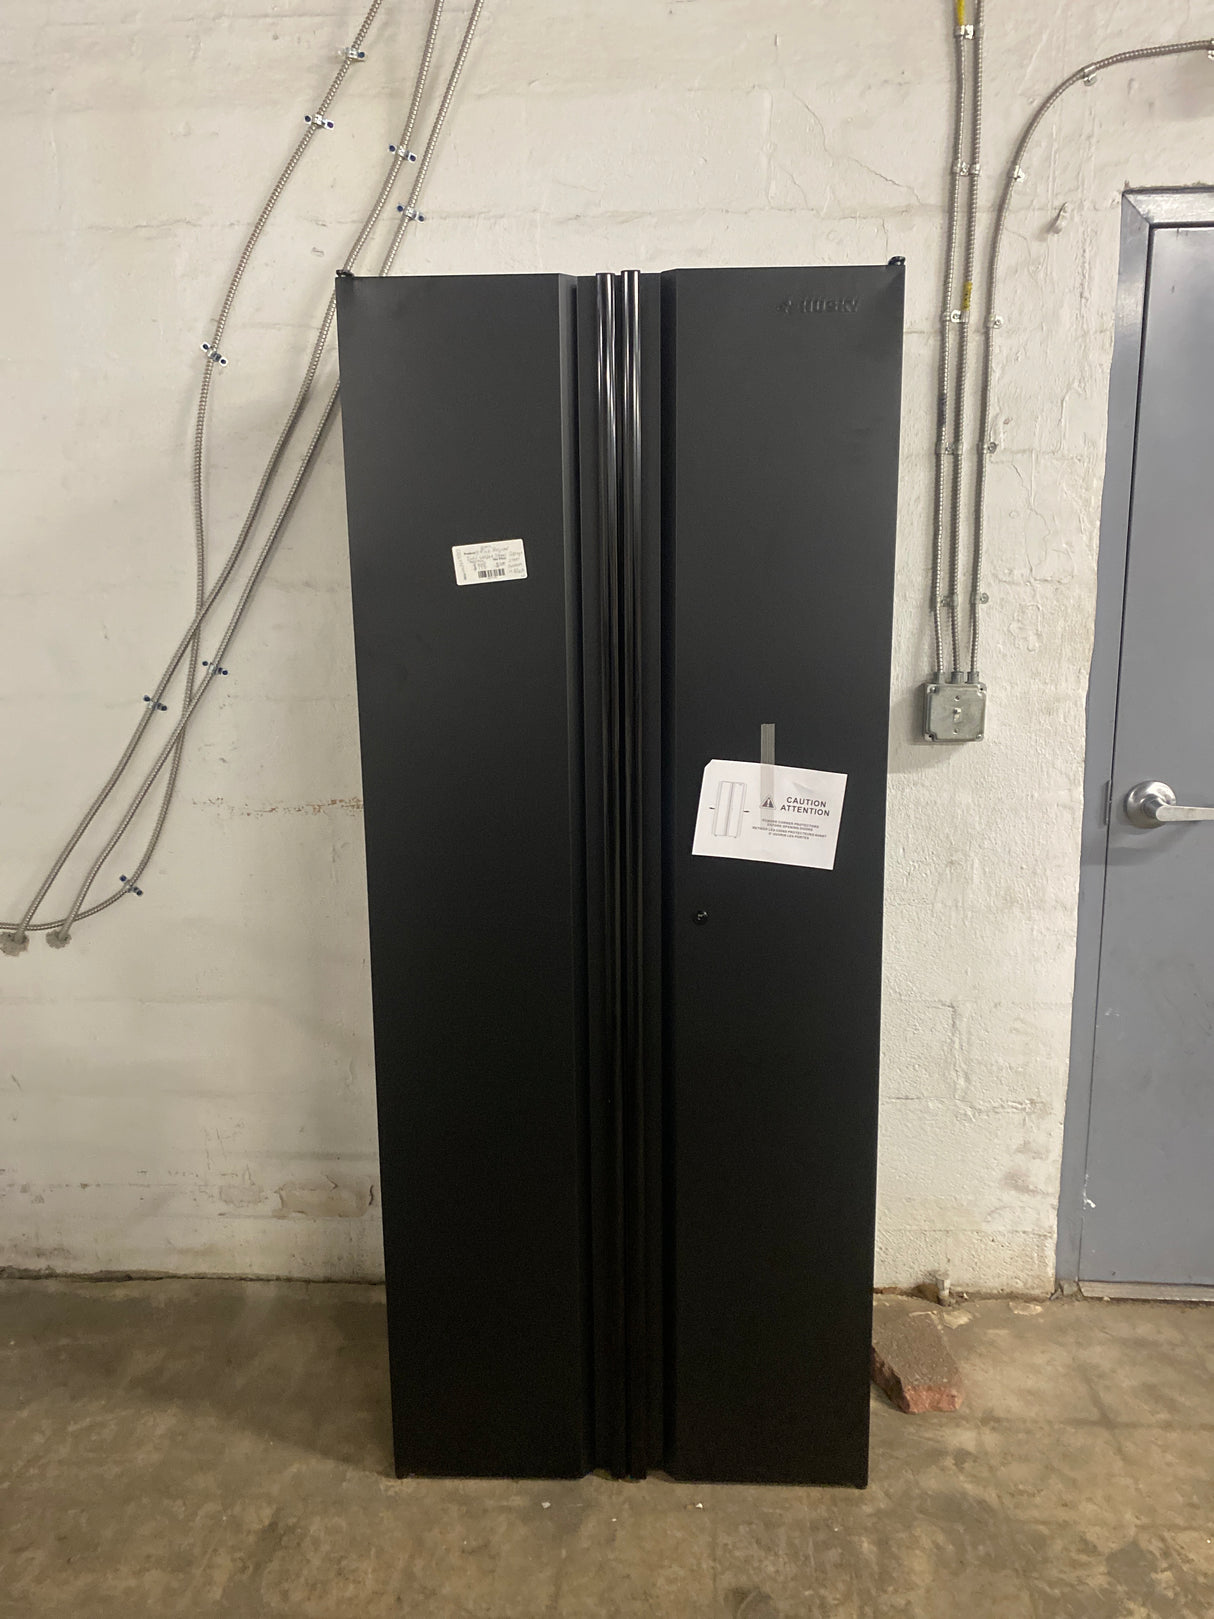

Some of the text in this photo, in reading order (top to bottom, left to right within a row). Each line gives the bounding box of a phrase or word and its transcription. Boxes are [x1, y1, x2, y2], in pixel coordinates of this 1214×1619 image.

[801, 298, 859, 313] HUSKY
[786, 796, 827, 808] CAUTION
[780, 804, 830, 816] ATTENTION
